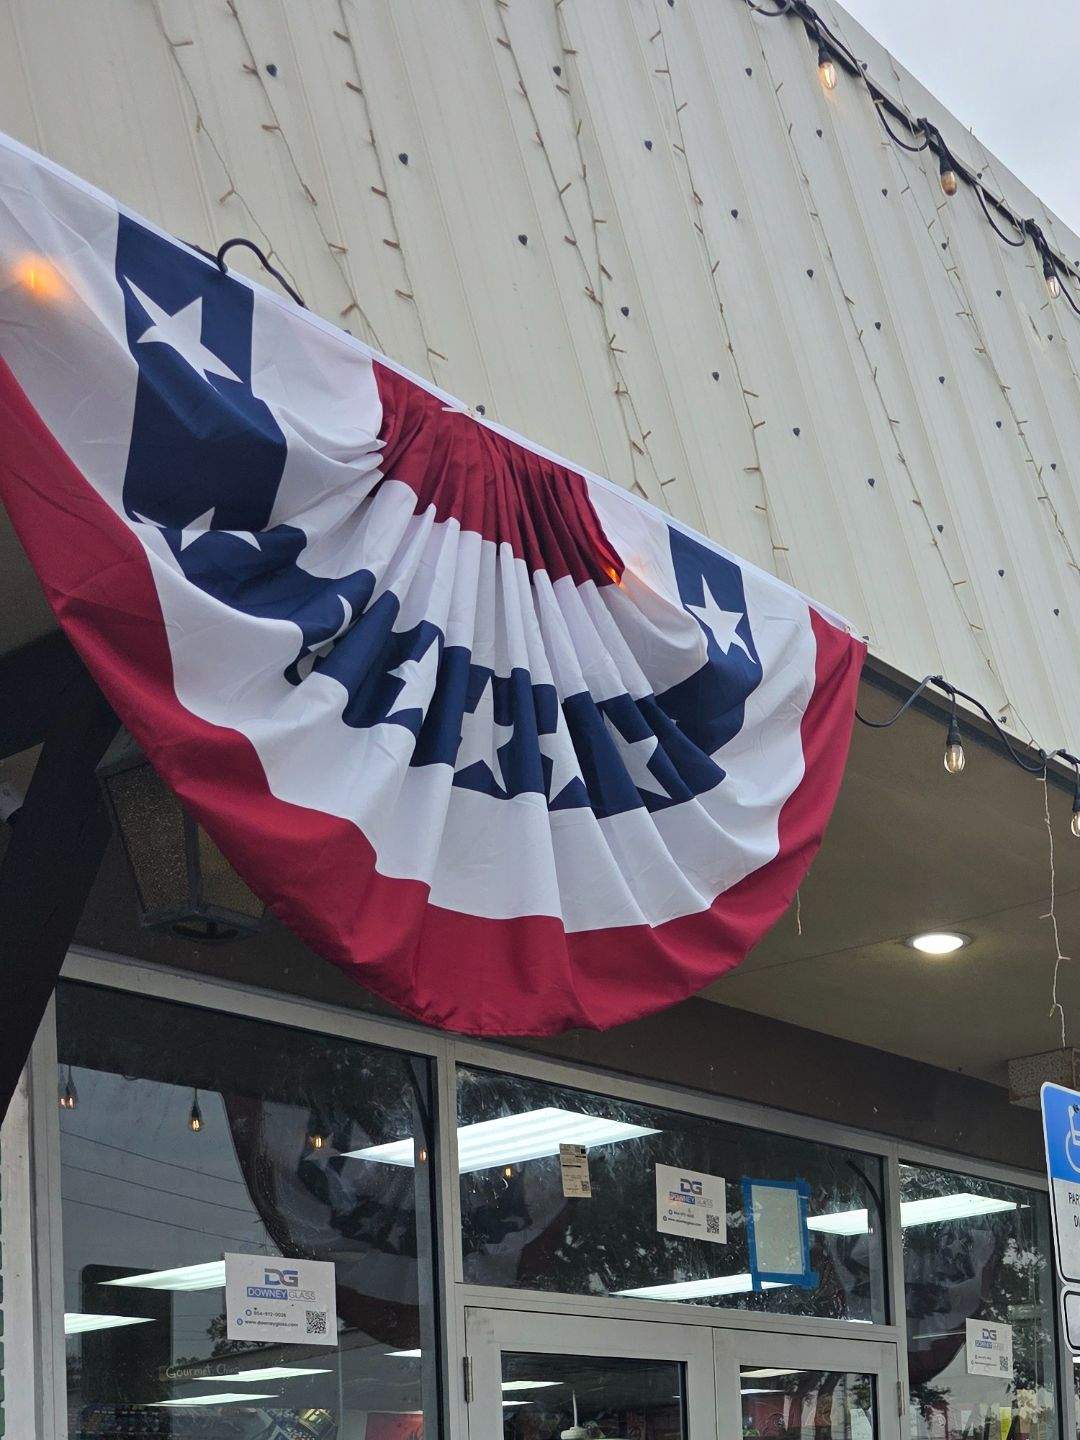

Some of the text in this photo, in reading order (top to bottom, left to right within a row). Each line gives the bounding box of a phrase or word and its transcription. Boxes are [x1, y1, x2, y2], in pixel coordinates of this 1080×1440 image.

[264, 1267, 299, 1288] DG
[247, 1288, 316, 1301] DOWNEY GLASS
[166, 1364, 213, 1379] Gourmet
